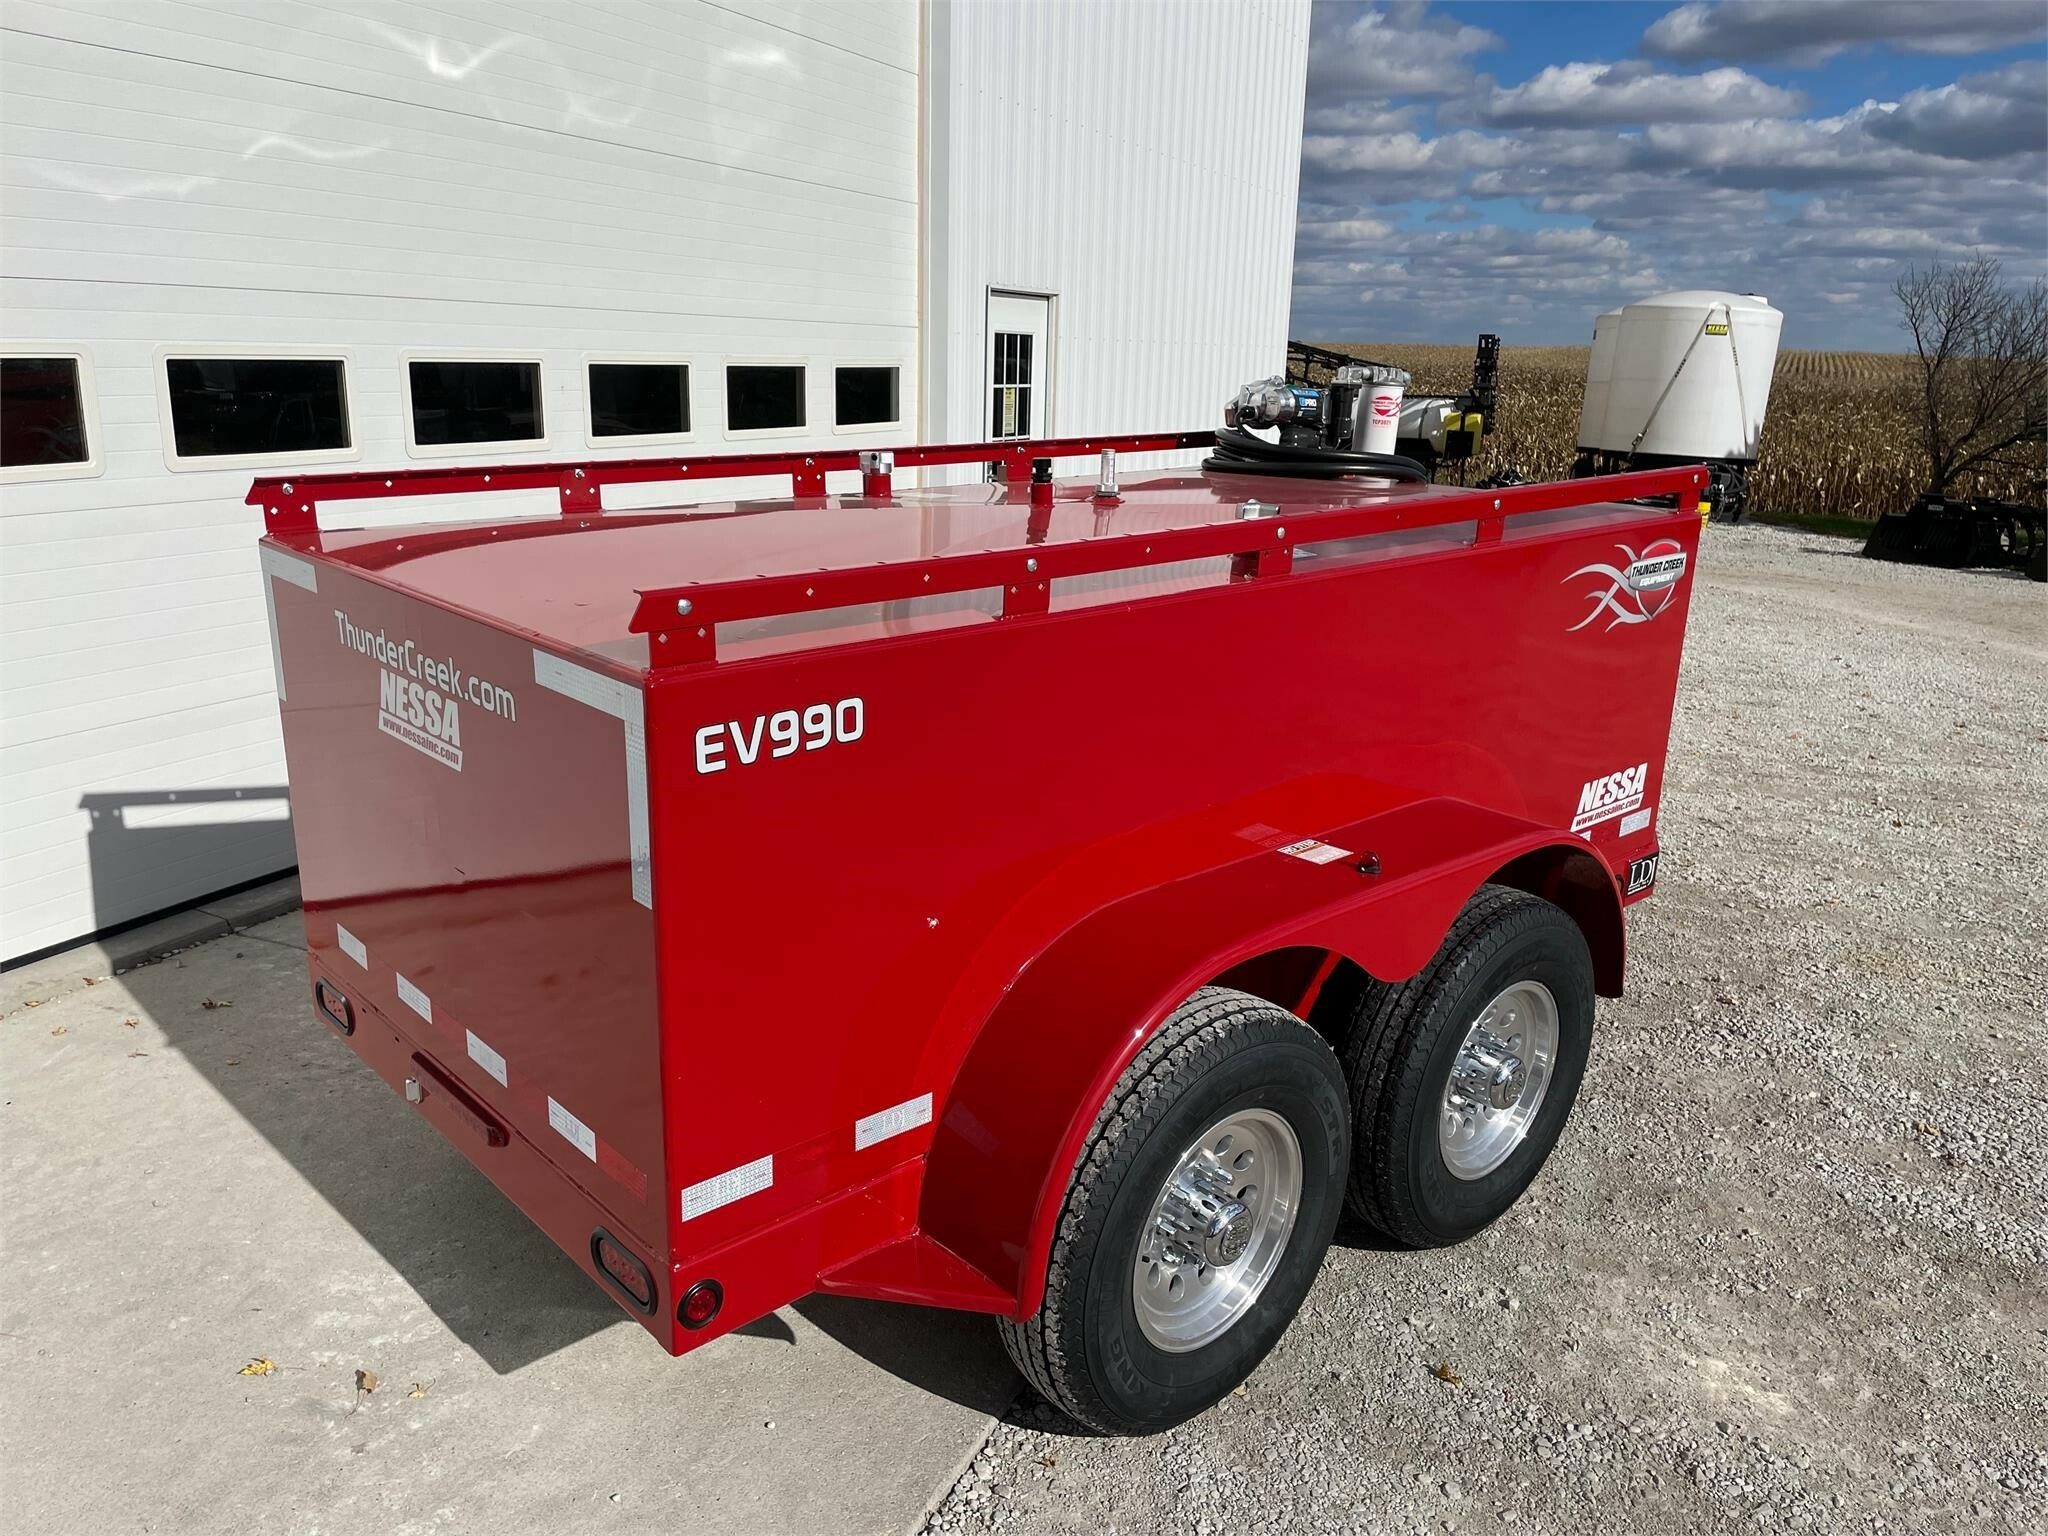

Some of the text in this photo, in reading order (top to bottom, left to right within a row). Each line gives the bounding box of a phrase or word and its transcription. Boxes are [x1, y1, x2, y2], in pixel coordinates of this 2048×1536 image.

[1632, 557, 1685, 578] THUNDER CREEK
[1639, 572, 1675, 587] EQUIPMENT
[334, 609, 516, 722] ThunderCreek.com
[380, 667, 461, 748] NESSA
[382, 717, 459, 765] www.nessainc.com
[694, 697, 865, 774] EV990
[1575, 796, 1641, 828] www.nessainc.com
[1576, 762, 1648, 816] NESSA
[1628, 856, 1658, 888] LDJ
